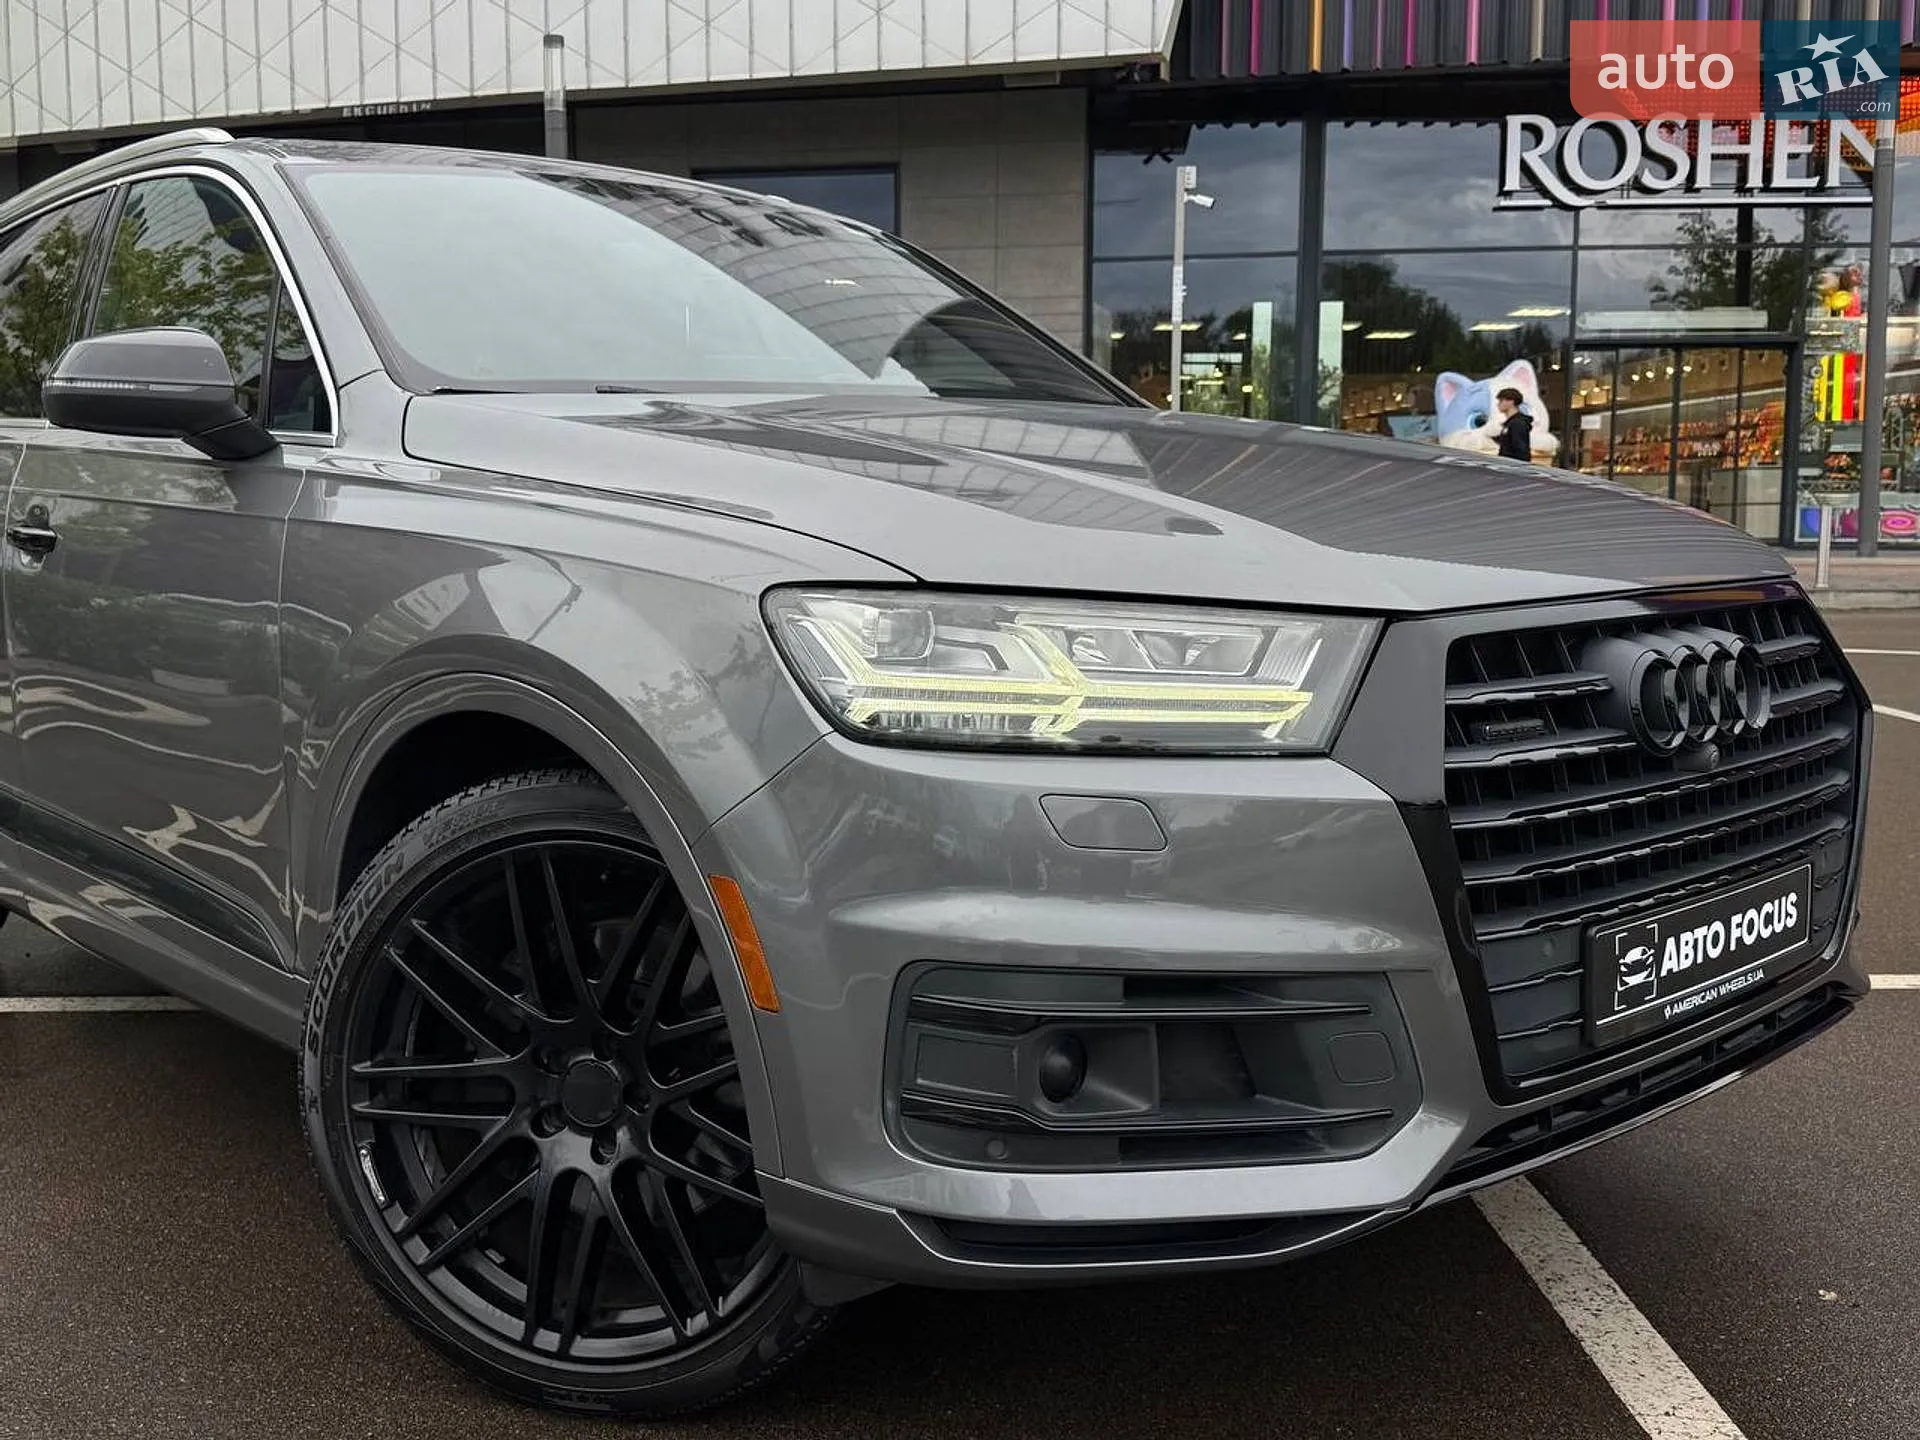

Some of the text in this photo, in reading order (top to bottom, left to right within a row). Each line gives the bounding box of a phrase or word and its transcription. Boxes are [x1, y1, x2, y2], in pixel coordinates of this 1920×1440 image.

[1502, 111, 1876, 204] ROSHEN
[307, 856, 405, 1059] SCORPION
[1730, 892, 1798, 951] FOCUS
[1672, 987, 1718, 1016] AMERICAN
